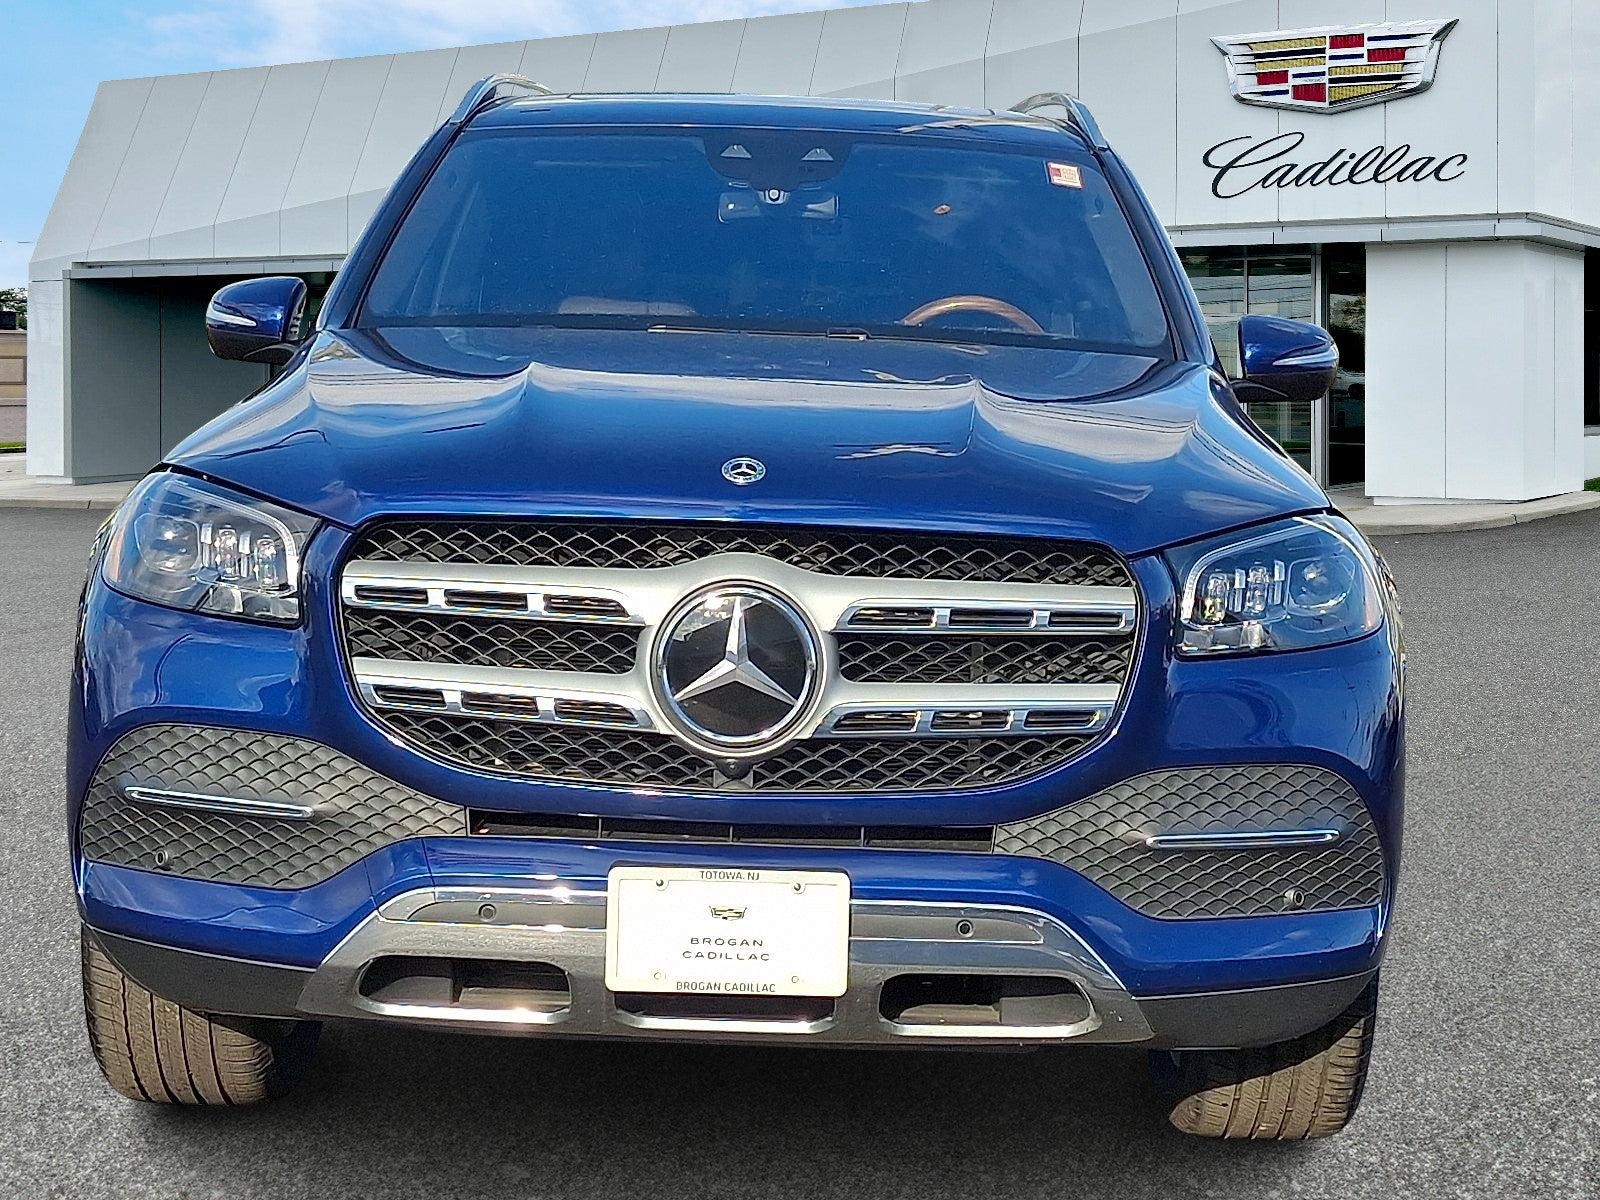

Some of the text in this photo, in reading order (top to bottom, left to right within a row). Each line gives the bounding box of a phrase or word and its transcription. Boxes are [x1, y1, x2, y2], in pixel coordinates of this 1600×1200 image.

[1202, 131, 1468, 199] Cadillac
[747, 871, 760, 881] NJ
[690, 937, 763, 947] BROGAN
[682, 950, 770, 962] CADILLAC
[676, 981, 776, 993] BROGAN CADILLAC
